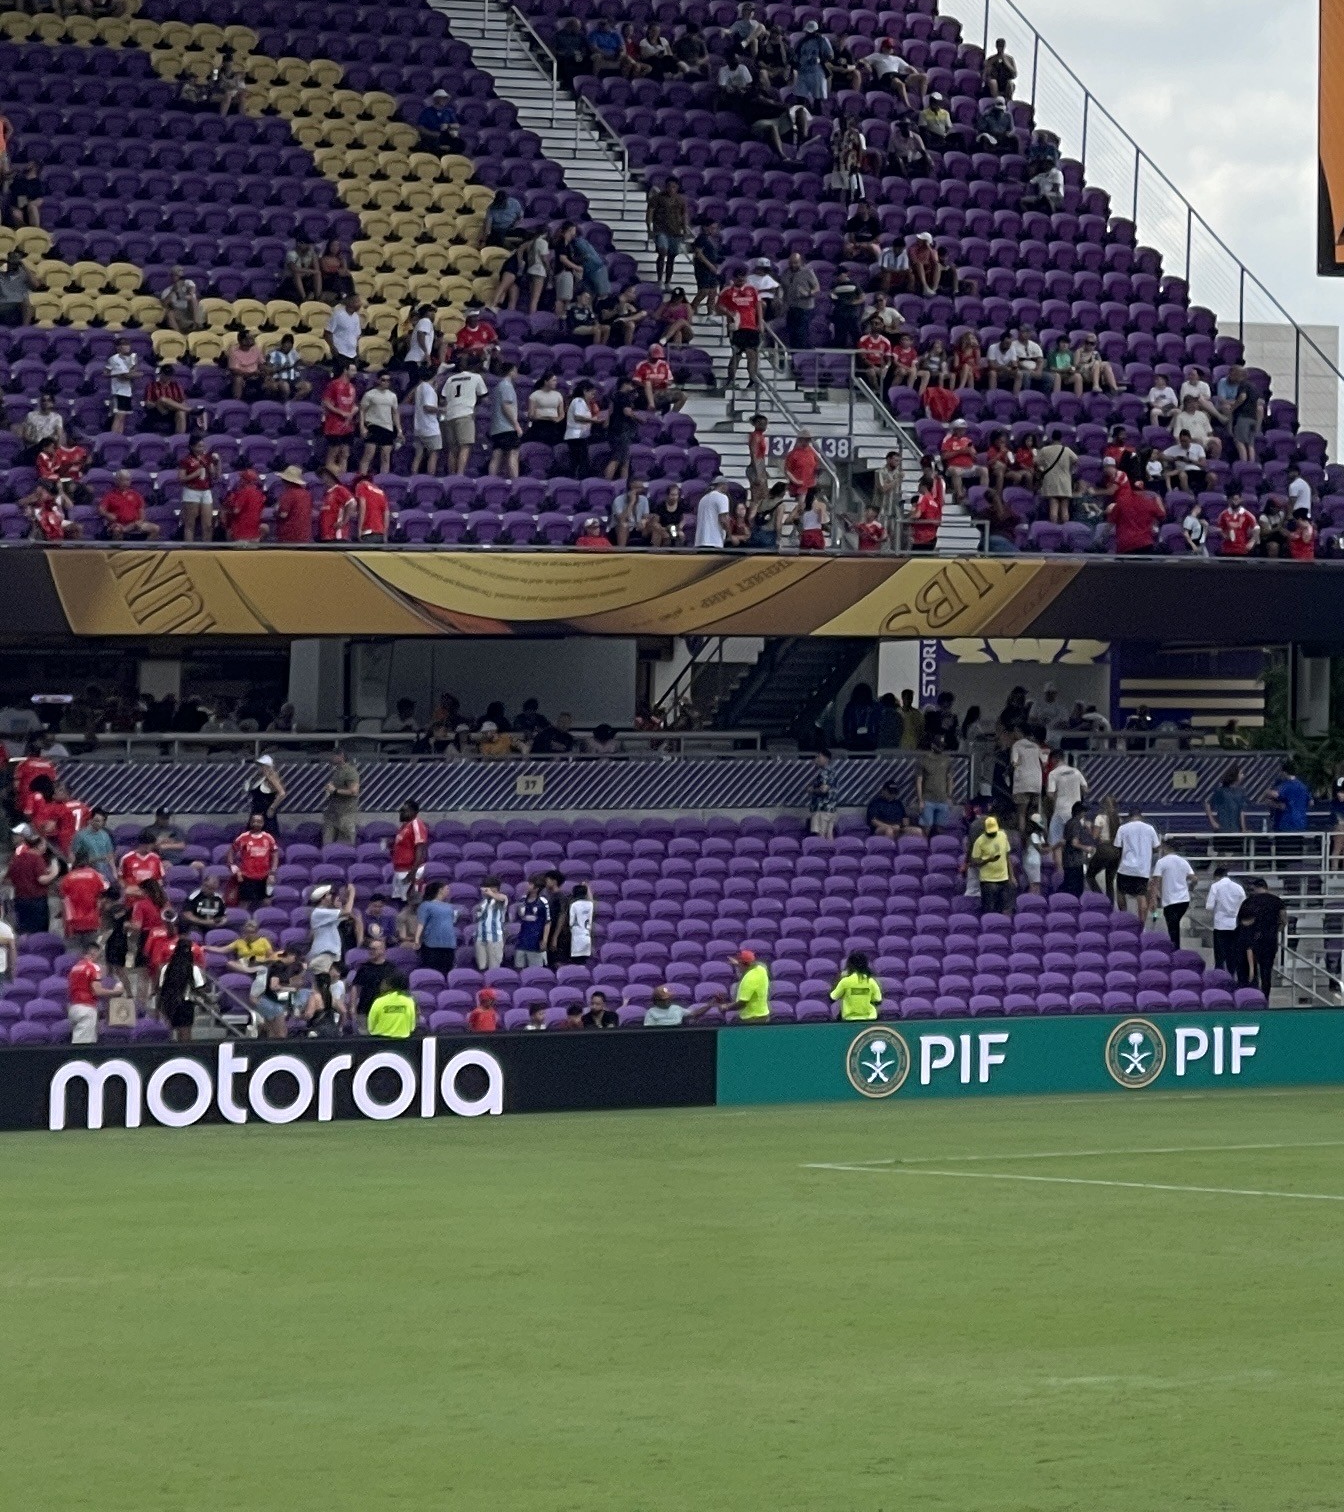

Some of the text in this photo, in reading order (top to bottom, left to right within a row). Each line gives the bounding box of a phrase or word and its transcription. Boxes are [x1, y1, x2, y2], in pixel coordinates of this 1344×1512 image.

[772, 437, 798, 456] 37
[825, 438, 849, 458] 38
[920, 1033, 1009, 1084] PIF
[1175, 1025, 1260, 1076] PIF
[50, 1037, 503, 1130] motorola
